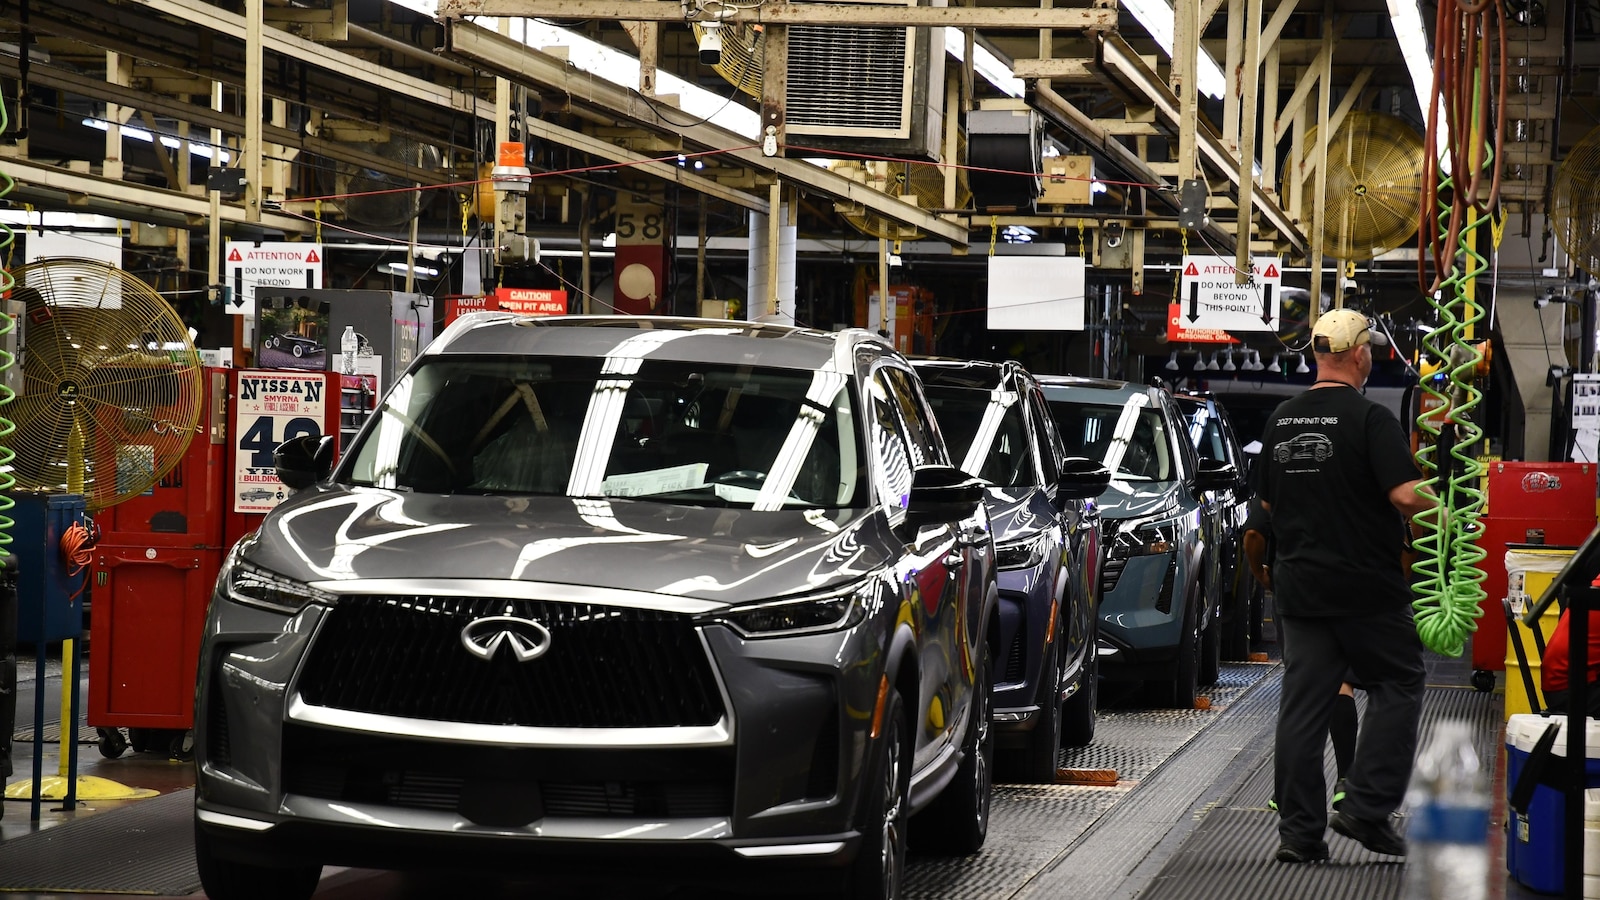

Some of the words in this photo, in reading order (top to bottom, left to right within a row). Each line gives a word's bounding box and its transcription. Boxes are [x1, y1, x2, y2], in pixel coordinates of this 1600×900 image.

[617, 214, 661, 239] 58
[247, 252, 302, 260] ATTENTION
[1204, 266, 1261, 275] ATTENN
[1202, 281, 1214, 289] DO
[1216, 282, 1233, 290] NOT
[510, 291, 552, 301] CAUTION!
[458, 298, 486, 307] NOTIFY
[524, 302, 537, 310] PIT
[1205, 304, 1223, 312] THIS
[241, 379, 322, 402] NISSAN
[264, 395, 299, 403] SMYRNA
[1276, 418, 1293, 427] 2027
[1320, 417, 1338, 425] QX65
